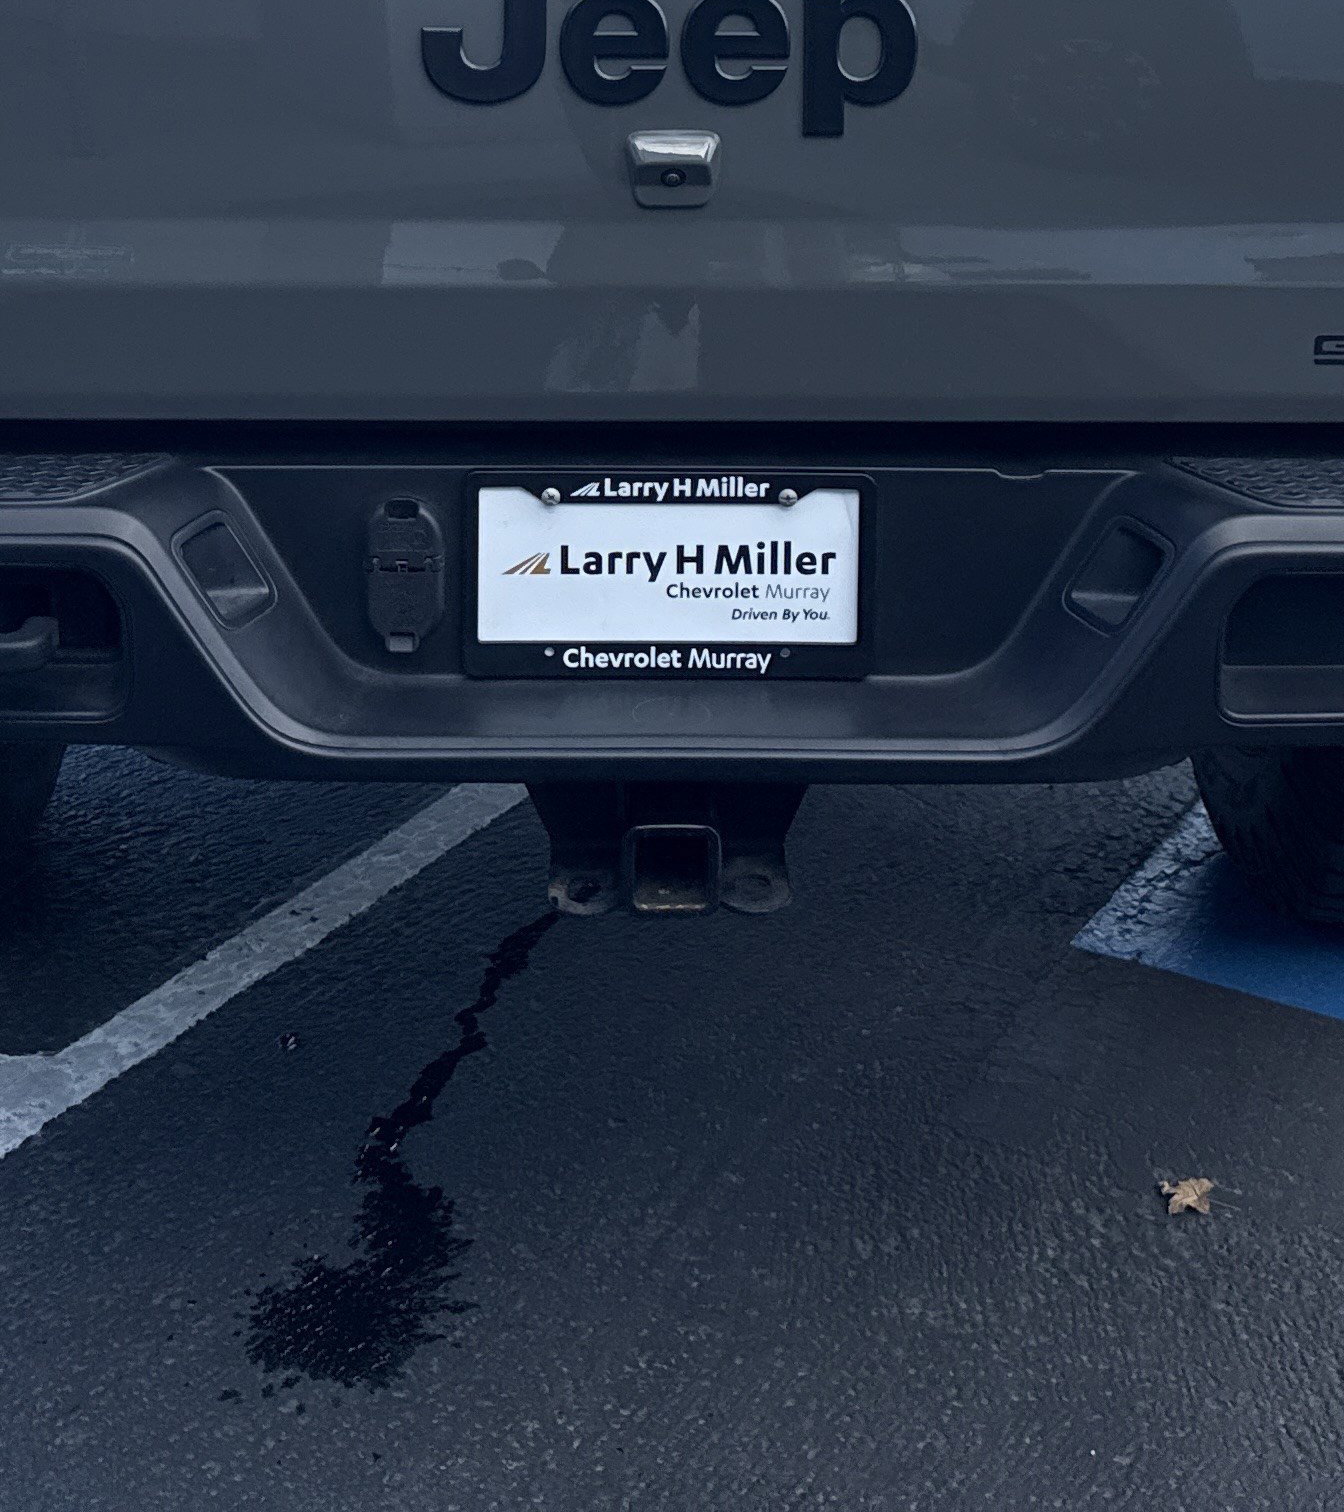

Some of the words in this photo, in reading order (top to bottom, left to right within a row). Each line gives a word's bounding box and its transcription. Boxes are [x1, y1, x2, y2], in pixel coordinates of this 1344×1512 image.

[603, 477, 670, 502] Larry
[673, 477, 692, 498] H
[695, 475, 771, 498] Miller
[560, 544, 668, 582] Larry
[675, 544, 705, 575] H
[713, 540, 837, 576] Miller
[666, 582, 760, 600] Chevrolet
[764, 583, 831, 603] Murray
[731, 607, 778, 621] Driven
[782, 608, 800, 623] By
[562, 645, 683, 669] Chevrolet
[687, 647, 772, 675] Murray
